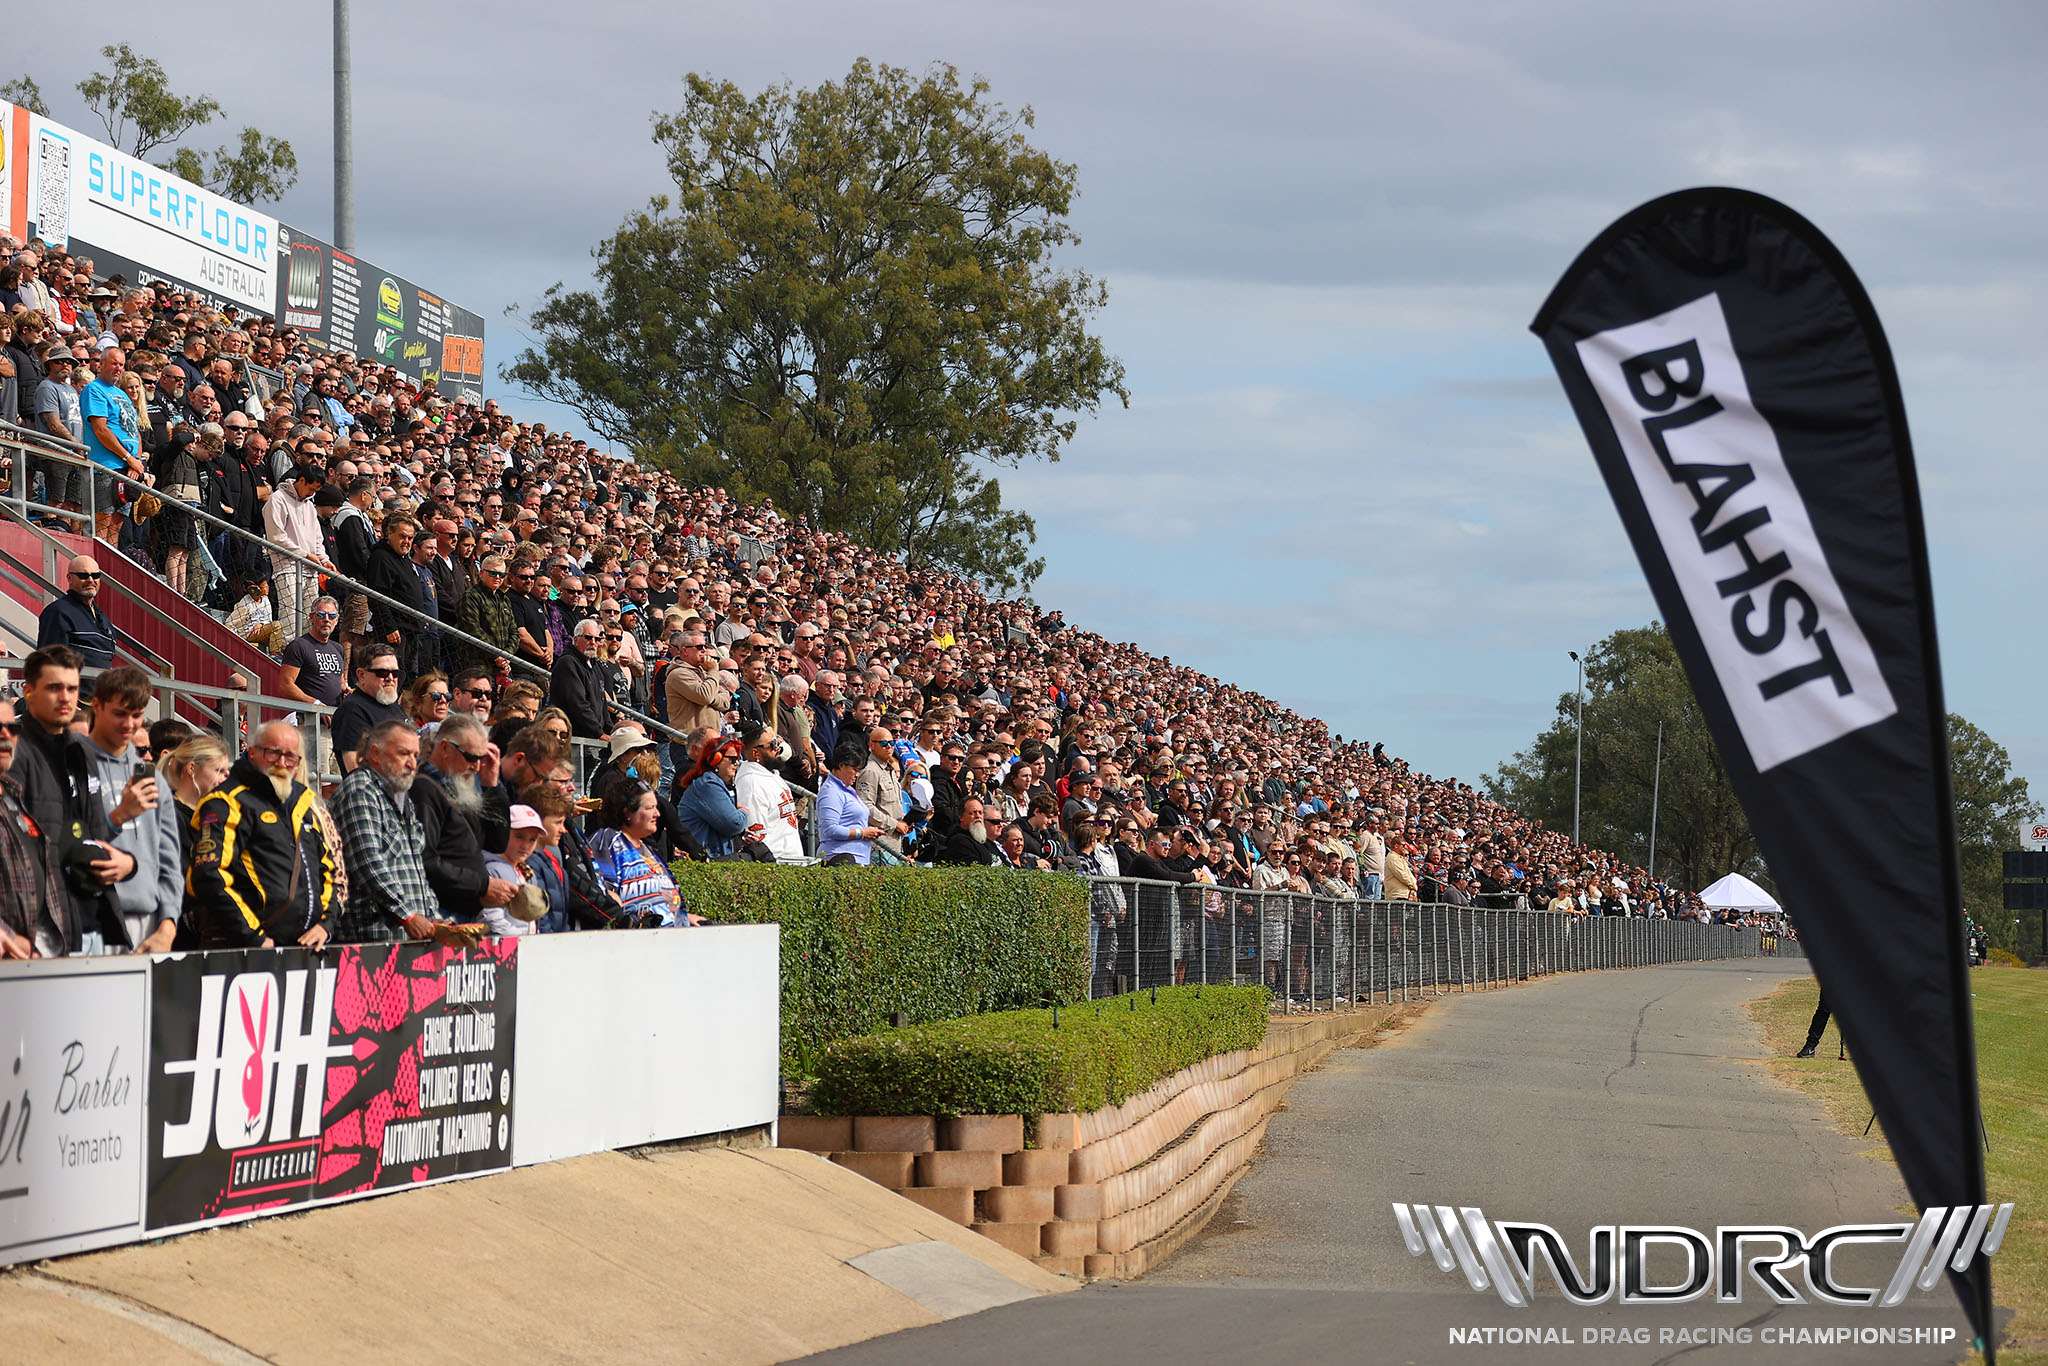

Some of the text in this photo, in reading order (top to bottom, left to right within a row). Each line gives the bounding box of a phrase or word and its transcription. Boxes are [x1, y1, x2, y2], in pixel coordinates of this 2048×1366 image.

[89, 152, 267, 262] SUPERFLOOR
[199, 255, 266, 303] AUSTRALIA
[1620, 338, 1854, 702] BLAHST
[316, 652, 339, 663] RIDE
[446, 963, 496, 1004] TAILSHAFTS
[423, 1012, 496, 1057] ENGINE BUILDING
[54, 1039, 131, 1115] Barber
[162, 968, 338, 1158] JOH
[419, 1062, 493, 1110] CYLINDER HEADS
[58, 1129, 122, 1168] Yamanto
[381, 1111, 492, 1167] AUTOMOTIVE MACHINING
[234, 1150, 316, 1185] ENGINEERING
